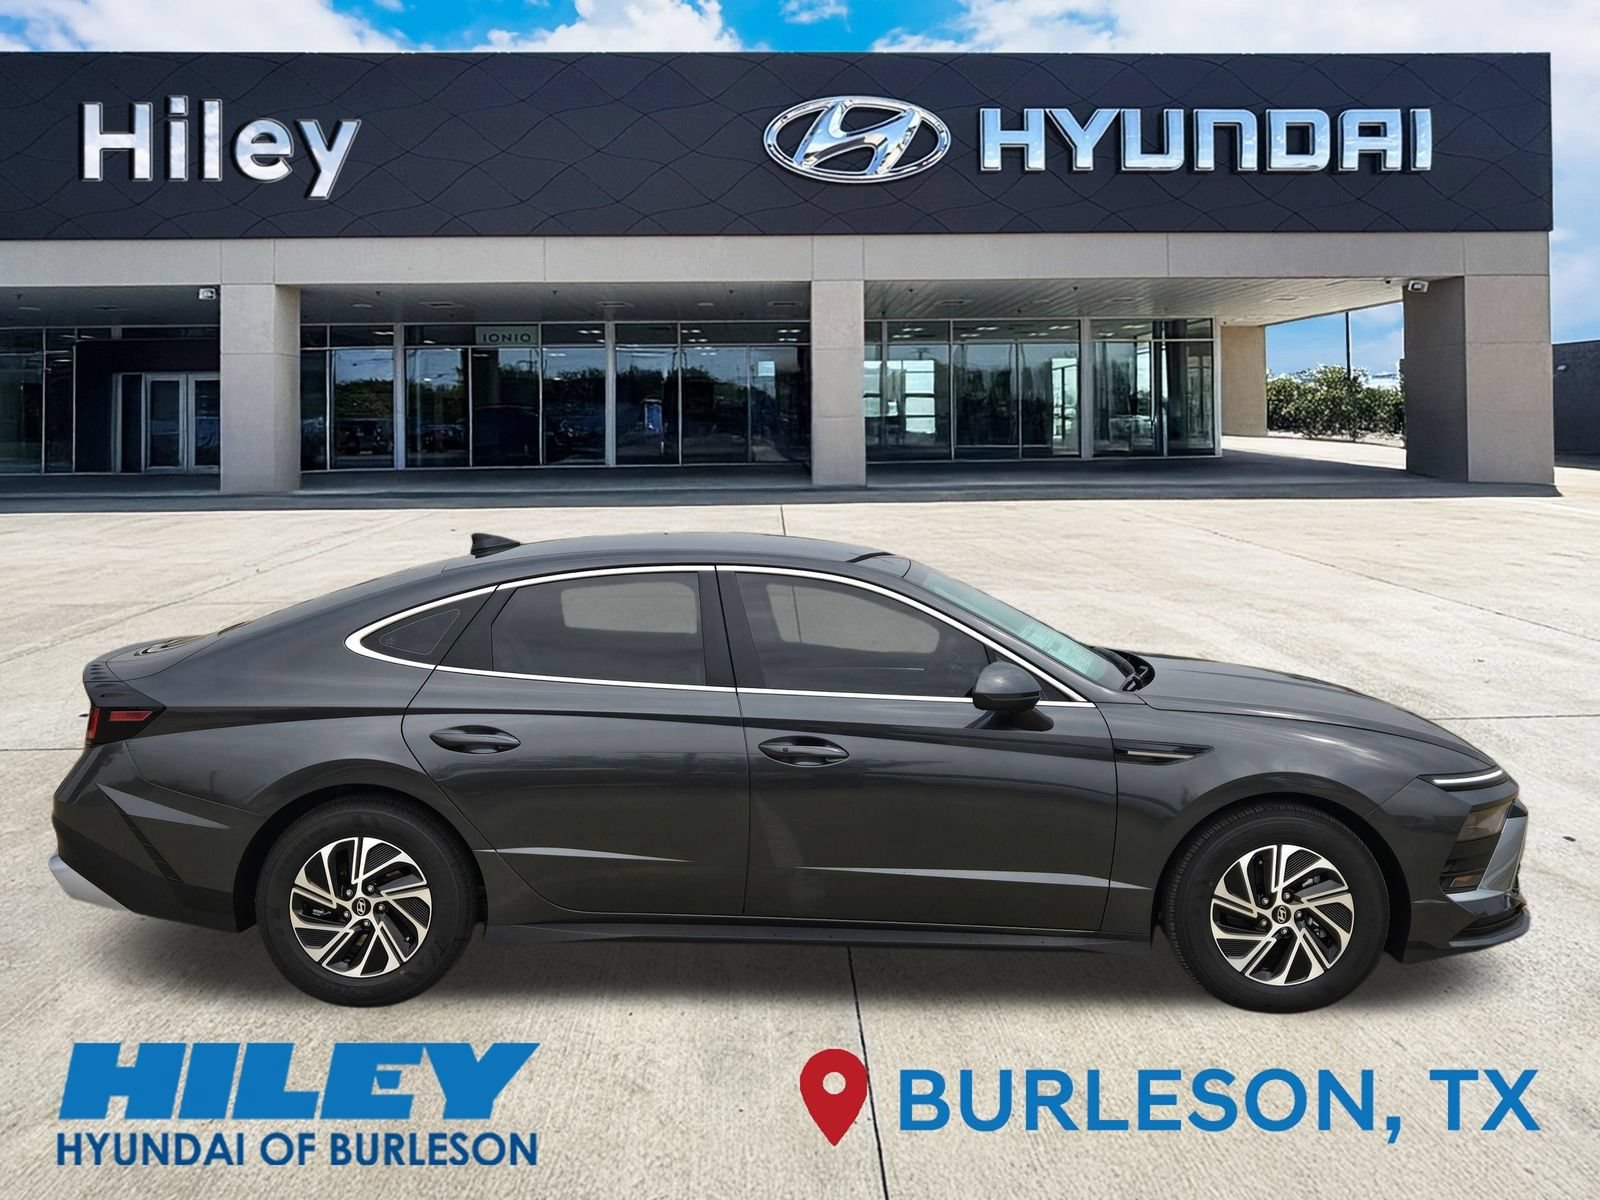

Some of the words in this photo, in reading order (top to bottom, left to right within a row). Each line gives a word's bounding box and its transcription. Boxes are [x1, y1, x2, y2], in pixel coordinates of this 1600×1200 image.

[80, 96, 361, 199] Hiley
[980, 108, 1432, 172] HYUNDAI
[483, 333, 531, 342] IONIQ
